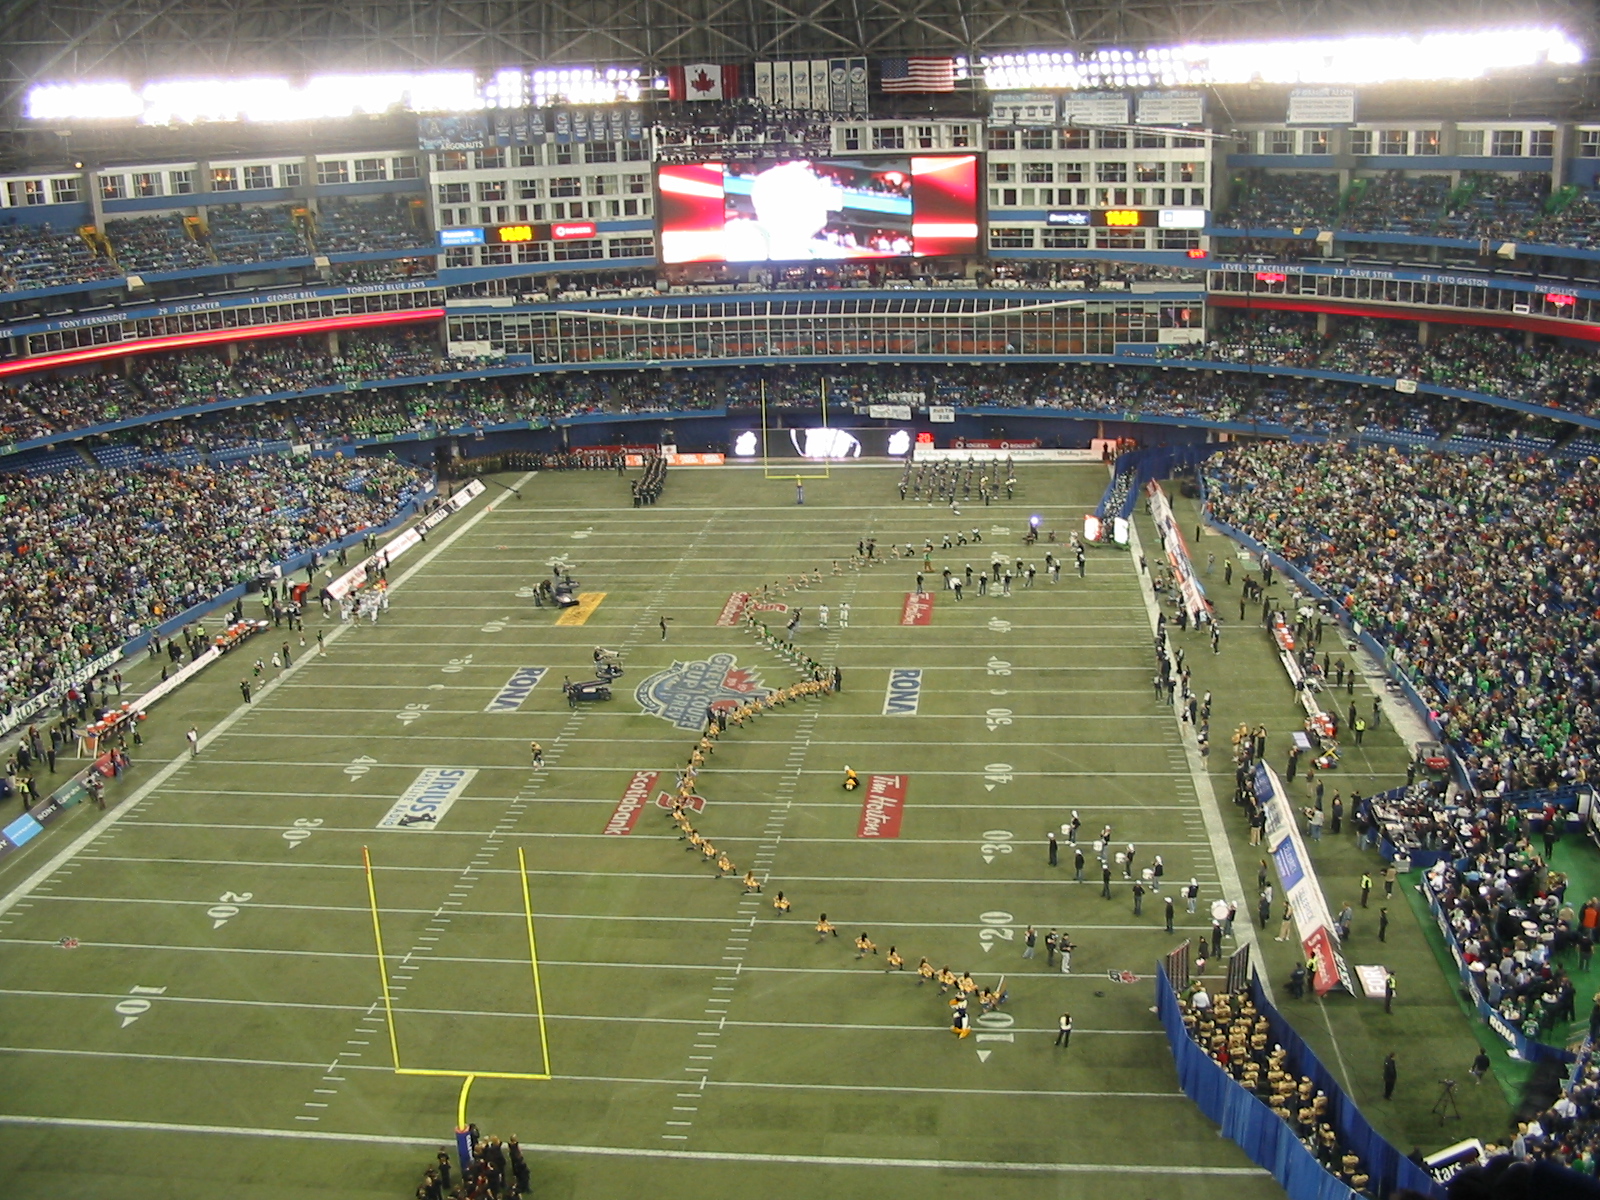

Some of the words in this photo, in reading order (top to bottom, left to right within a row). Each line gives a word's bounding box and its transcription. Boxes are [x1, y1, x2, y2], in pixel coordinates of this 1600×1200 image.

[440, 140, 484, 150] ARGONAUTS
[1221, 263, 1243, 271] LEVEL
[1256, 264, 1305, 274] EXCELLENCE
[1335, 268, 1343, 276] 37
[1350, 269, 1371, 278] DAVE
[346, 284, 384, 294] TORONTO
[386, 282, 404, 291] BLUE
[407, 281, 426, 289] JAYS
[1437, 275, 1455, 285] CITO
[1457, 277, 1489, 288] GASTON
[1534, 284, 1548, 294] PAT
[1550, 287, 1579, 297] GILLICK
[267, 292, 297, 302] GEORGE
[300, 290, 318, 299] BELL
[158, 307, 168, 315] 29
[175, 305, 189, 313] JOE
[191, 302, 220, 312] CARTER
[59, 319, 81, 329] TONY
[82, 313, 128, 326] FERNANDEZ
[917, 433, 931, 443] 20
[683, 662, 706, 688] CUP
[700, 655, 731, 689] GREY
[489, 667, 547, 711] RONA
[886, 669, 921, 715] RONA
[396, 703, 430, 720] 50
[669, 693, 690, 719] GREY
[681, 696, 708, 728] COUPE
[986, 708, 1013, 725] 50
[343, 755, 378, 775] 40
[984, 763, 1013, 784] 40
[403, 770, 437, 801] SATELLITE
[410, 769, 465, 812] SIRIUS
[36, 803, 58, 821] SONY
[604, 770, 657, 835] Scotiabank
[382, 804, 409, 826] RADIO
[863, 791, 898, 837] Hortons
[282, 818, 324, 840] 30
[980, 830, 1014, 854] 30
[206, 891, 253, 918] 20
[978, 911, 1015, 941] 20
[115, 984, 168, 1015] 10
[976, 1012, 1015, 1043] 10
[1489, 1014, 1517, 1046] RONA
